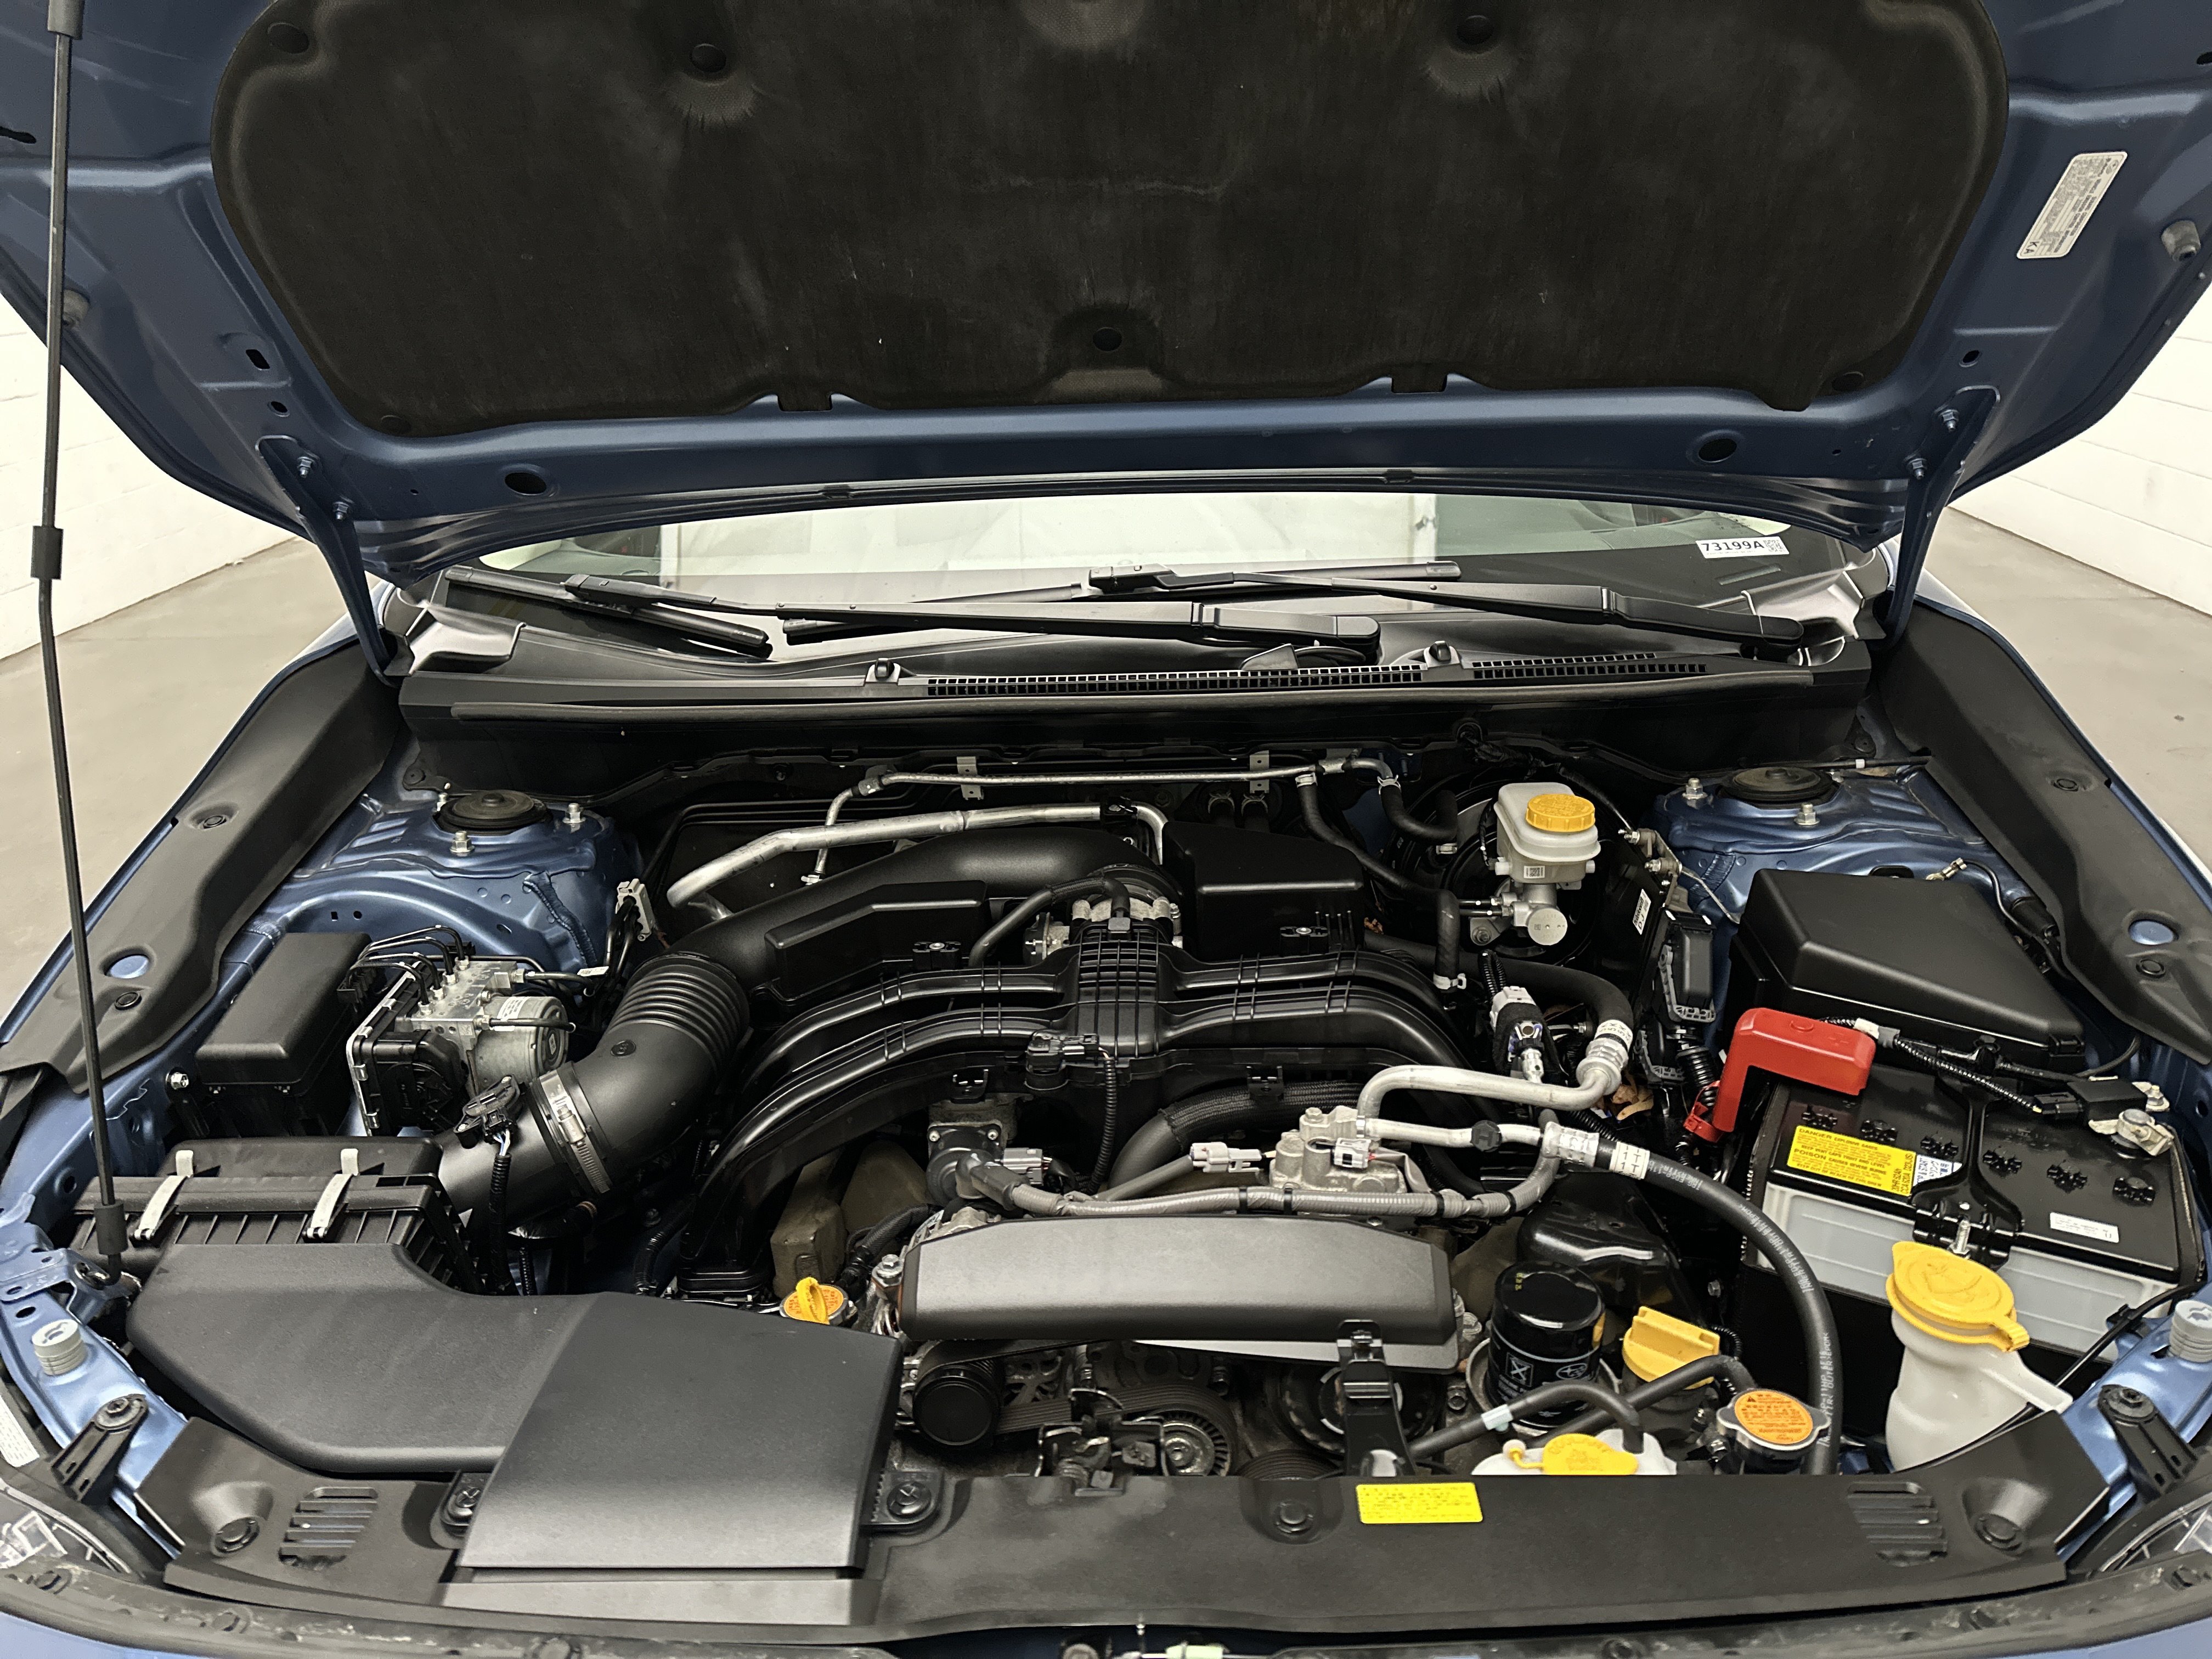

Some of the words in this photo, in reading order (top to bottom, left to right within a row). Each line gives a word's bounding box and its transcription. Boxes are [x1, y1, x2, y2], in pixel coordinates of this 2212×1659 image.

[2024, 241, 2040, 254] KA
[1701, 541, 1764, 551] 73199A
[1799, 1128, 1832, 1139] DANGER
[1794, 1148, 1827, 1160] POISON
